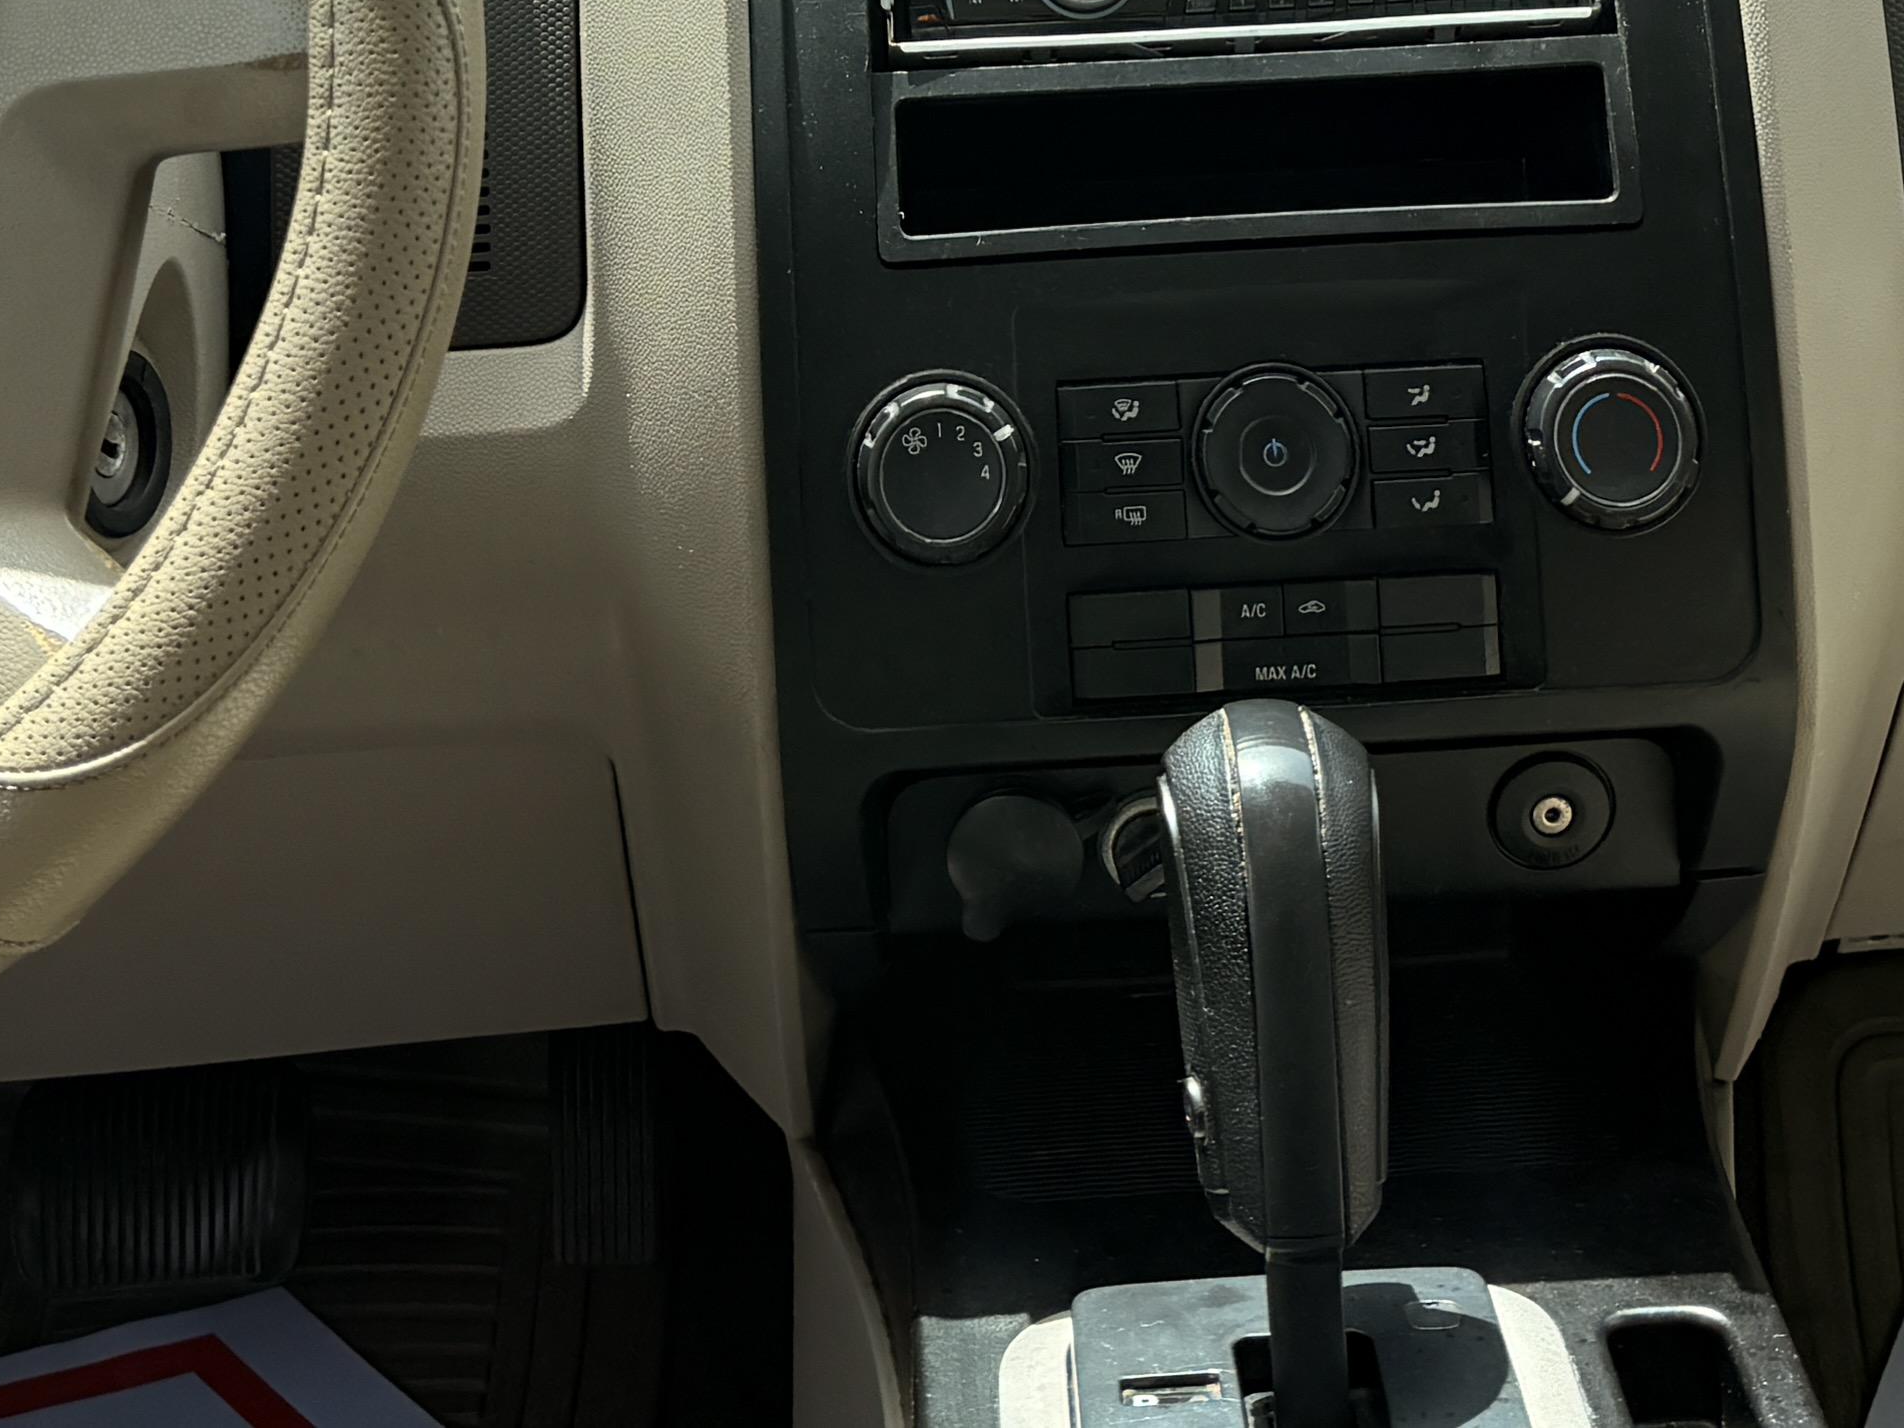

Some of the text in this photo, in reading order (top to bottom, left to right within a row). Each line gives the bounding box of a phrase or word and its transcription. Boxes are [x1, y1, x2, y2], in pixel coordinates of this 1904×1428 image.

[937, 422, 942, 439] 1
[956, 425, 966, 441] 2
[972, 441, 983, 457] 3
[980, 464, 990, 480] 4
[1240, 603, 1267, 618] A/C
[1255, 663, 1317, 681] MAX A/C
